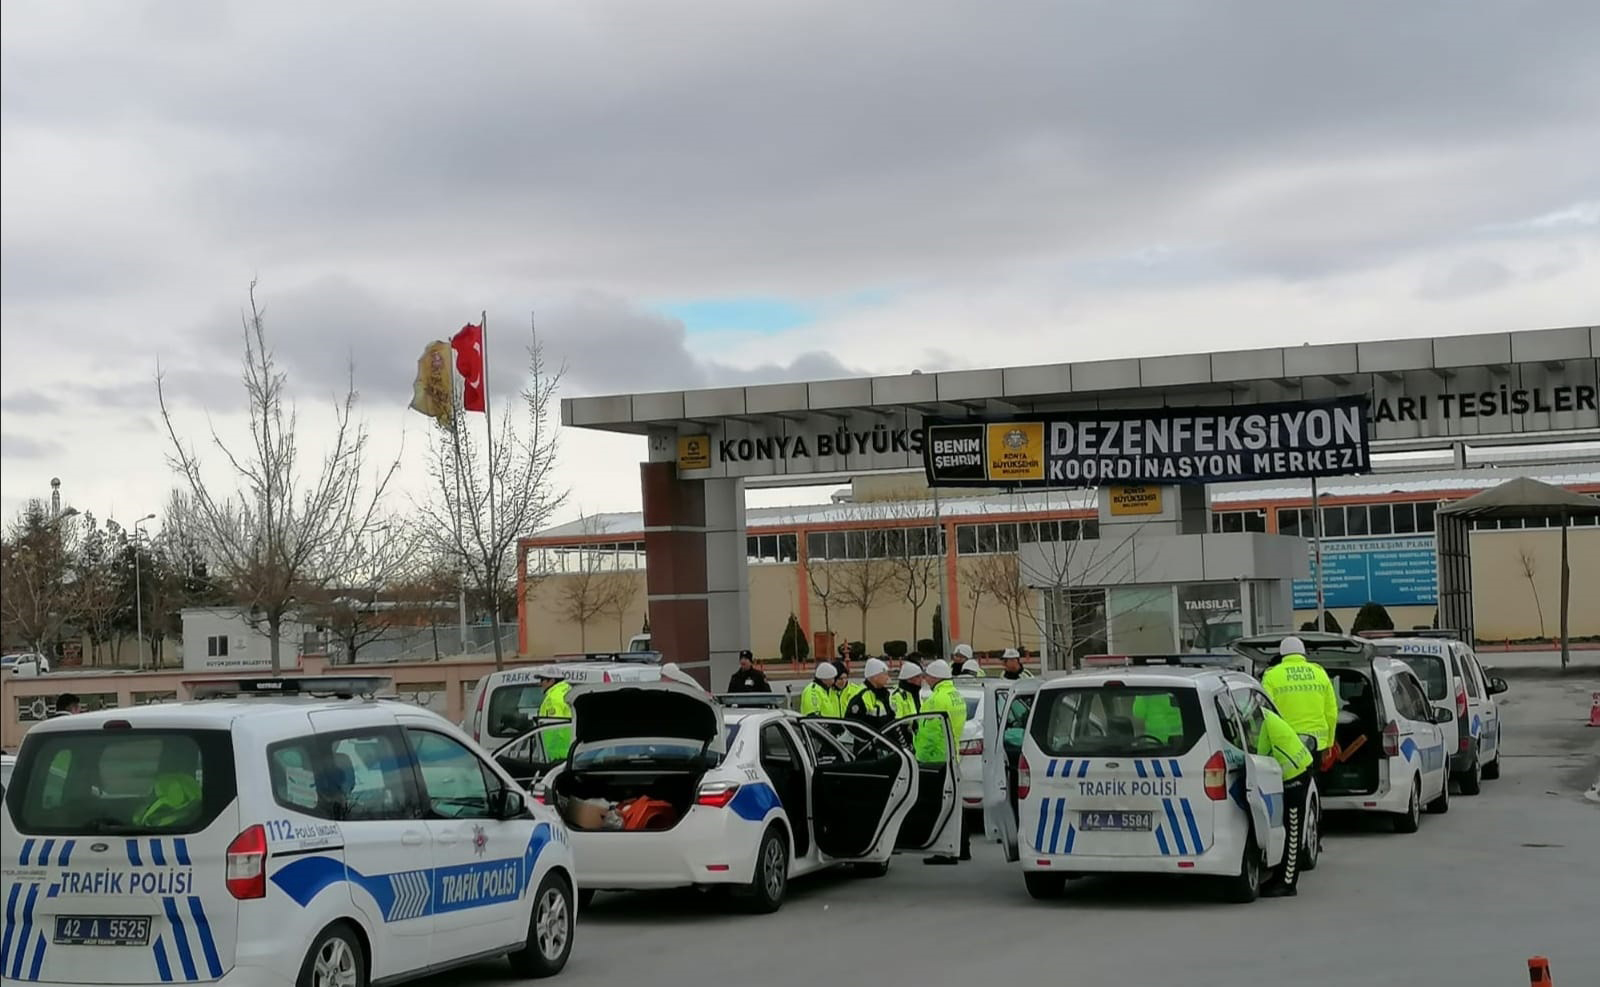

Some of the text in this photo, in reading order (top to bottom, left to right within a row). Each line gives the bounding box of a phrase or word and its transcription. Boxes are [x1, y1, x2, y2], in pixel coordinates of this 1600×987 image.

[1367, 384, 1596, 424] ARI TESİSLER
[1050, 406, 1361, 456] DEZENFEKSİYON
[719, 436, 812, 462] KONYA
[934, 438, 981, 454] BENİM
[935, 453, 981, 469] ŞEHRİM
[1050, 441, 1364, 480] KOORDİNASYON MERKEZİ
[1078, 777, 1177, 796] TRAFİK POLİSİ
[266, 819, 294, 841] 112
[1086, 814, 1100, 826] 42
[1107, 814, 1114, 826] A
[60, 867, 123, 894] TRAFİK
[130, 867, 193, 894] POLİSİ
[442, 862, 518, 904] TRAFİK POLİSİ
[63, 920, 146, 938] 42 A 5525
